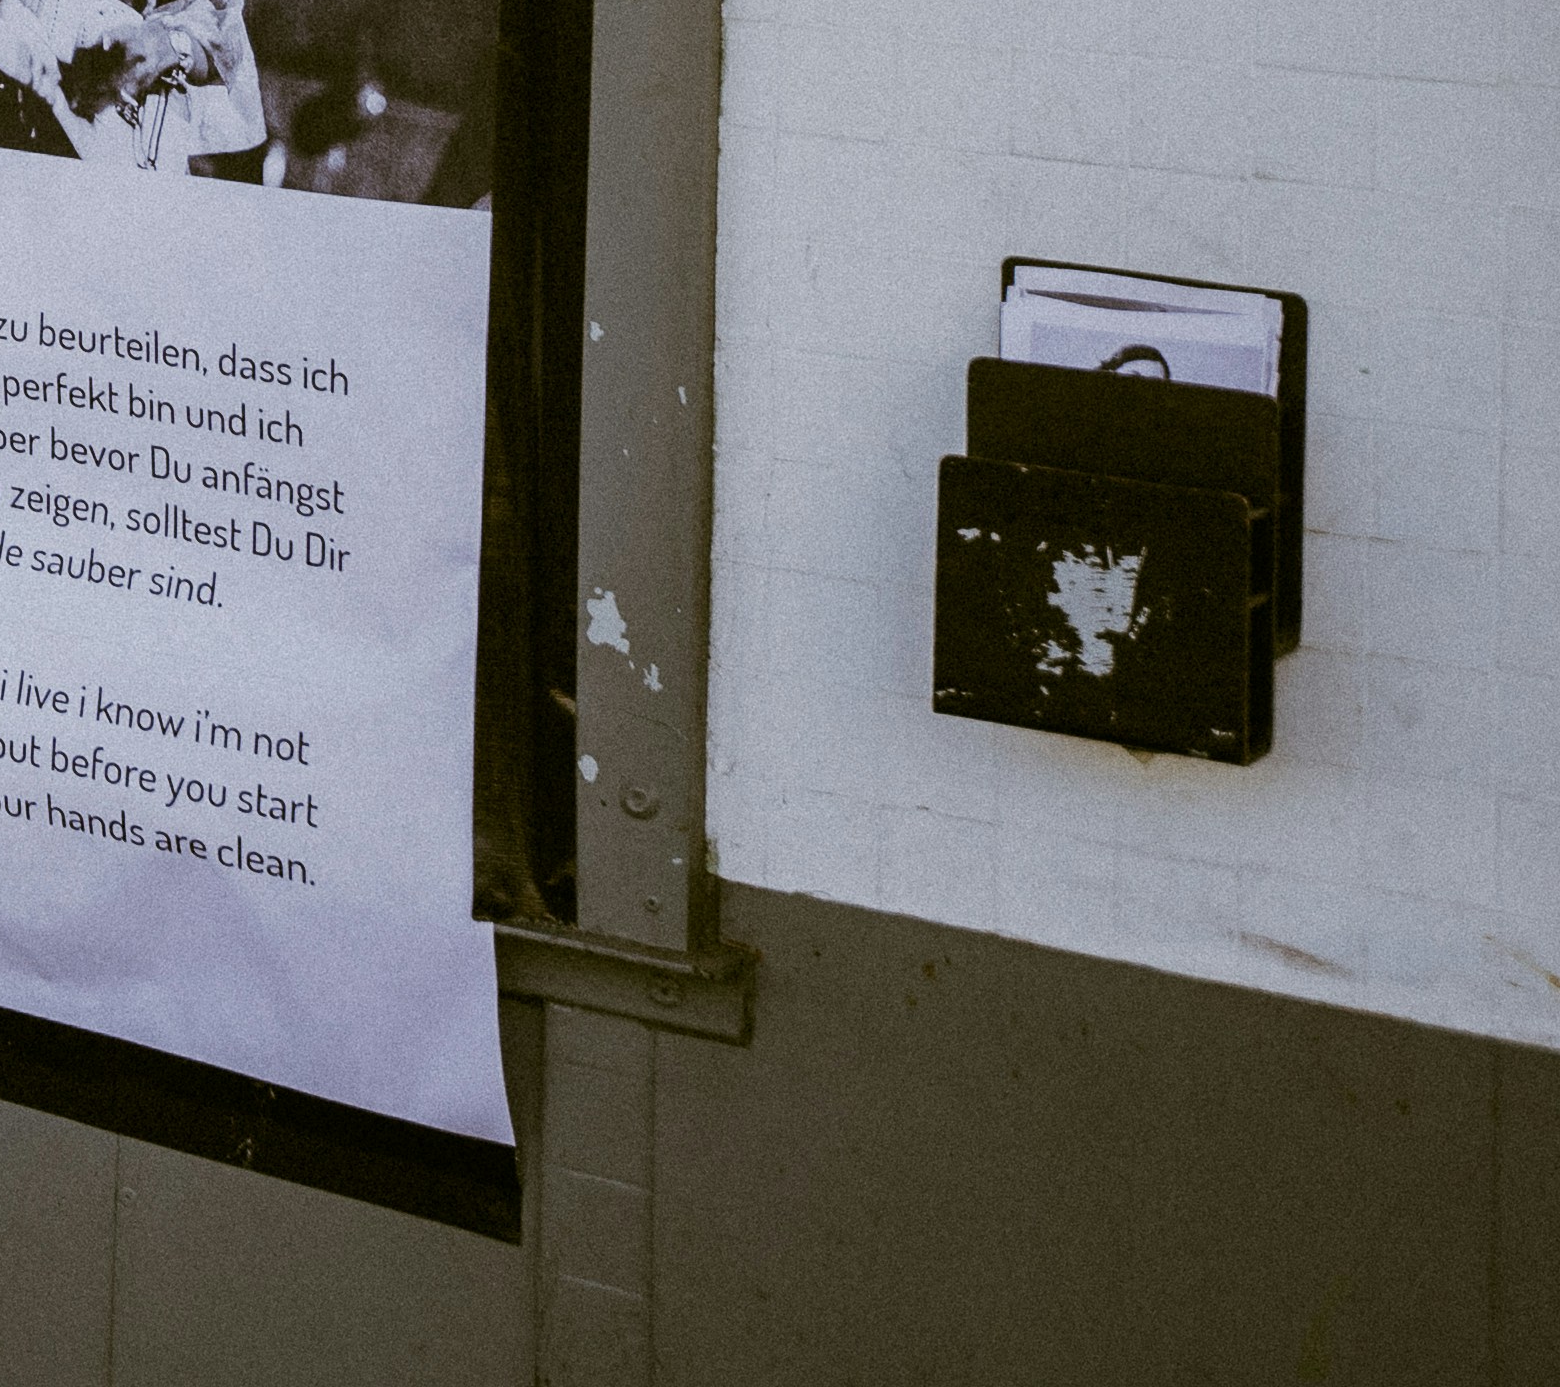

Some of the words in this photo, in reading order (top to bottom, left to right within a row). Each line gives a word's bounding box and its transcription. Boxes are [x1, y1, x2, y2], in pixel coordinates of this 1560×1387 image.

[38, 311, 209, 376] beurteilen,
[217, 342, 293, 387] dass
[302, 356, 350, 396] ich
[45, 792, 146, 847] hands
[154, 829, 208, 861] are
[216, 835, 316, 887] clean.
